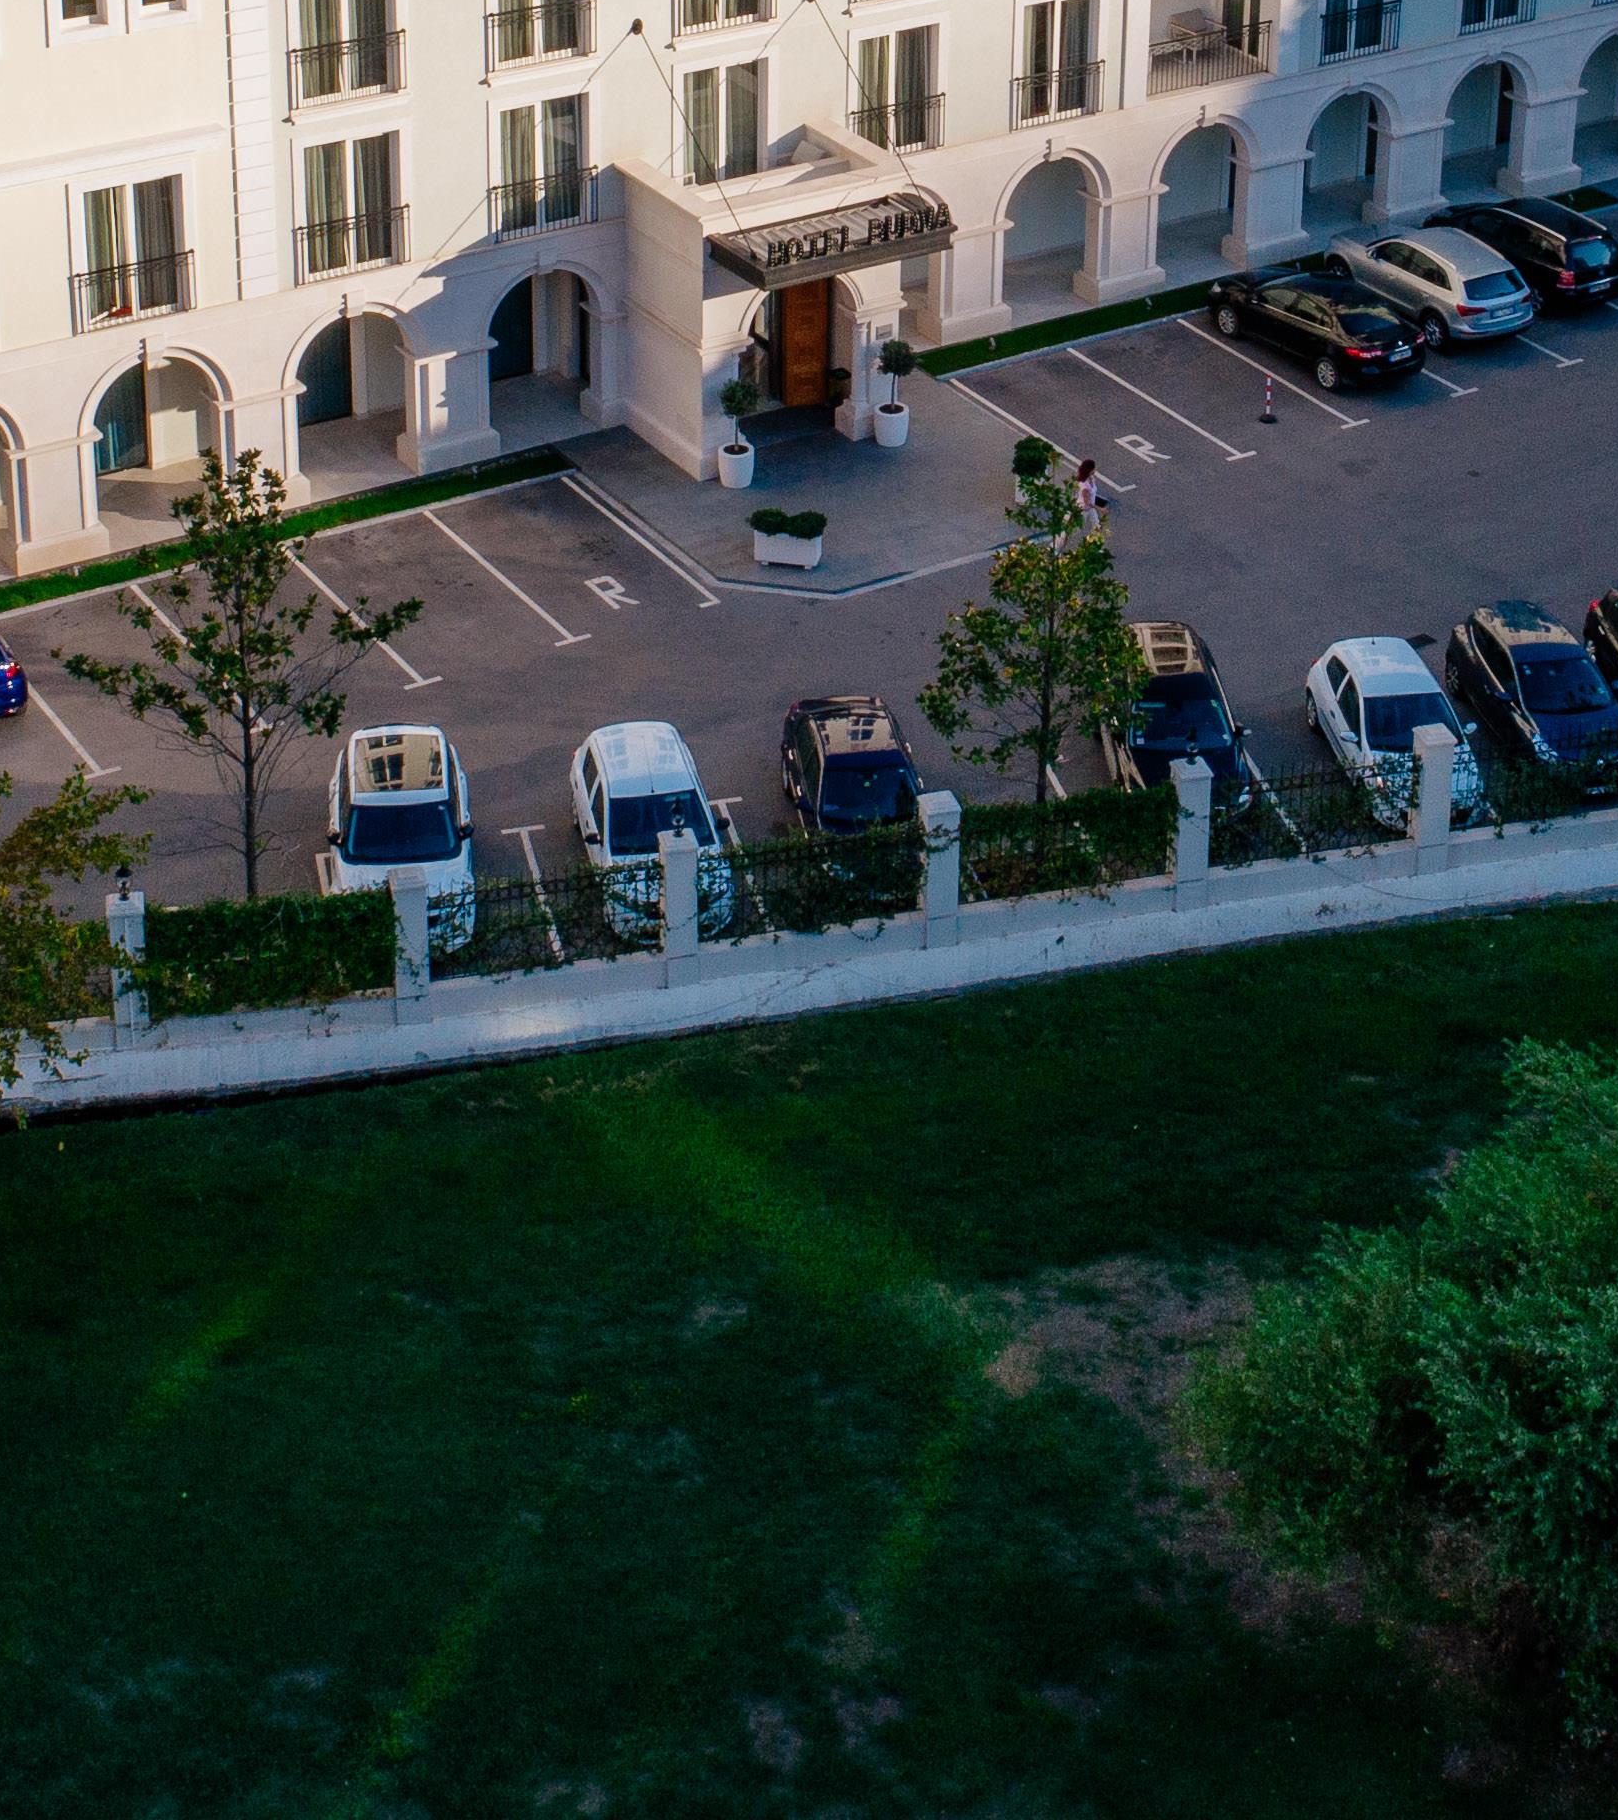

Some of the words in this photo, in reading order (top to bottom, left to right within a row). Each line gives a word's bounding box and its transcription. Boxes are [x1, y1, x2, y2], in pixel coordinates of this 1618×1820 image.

[767, 225, 850, 268] HOTEL
[868, 203, 951, 245] BUDVA
[1113, 434, 1172, 464] R
[584, 575, 641, 610] R
